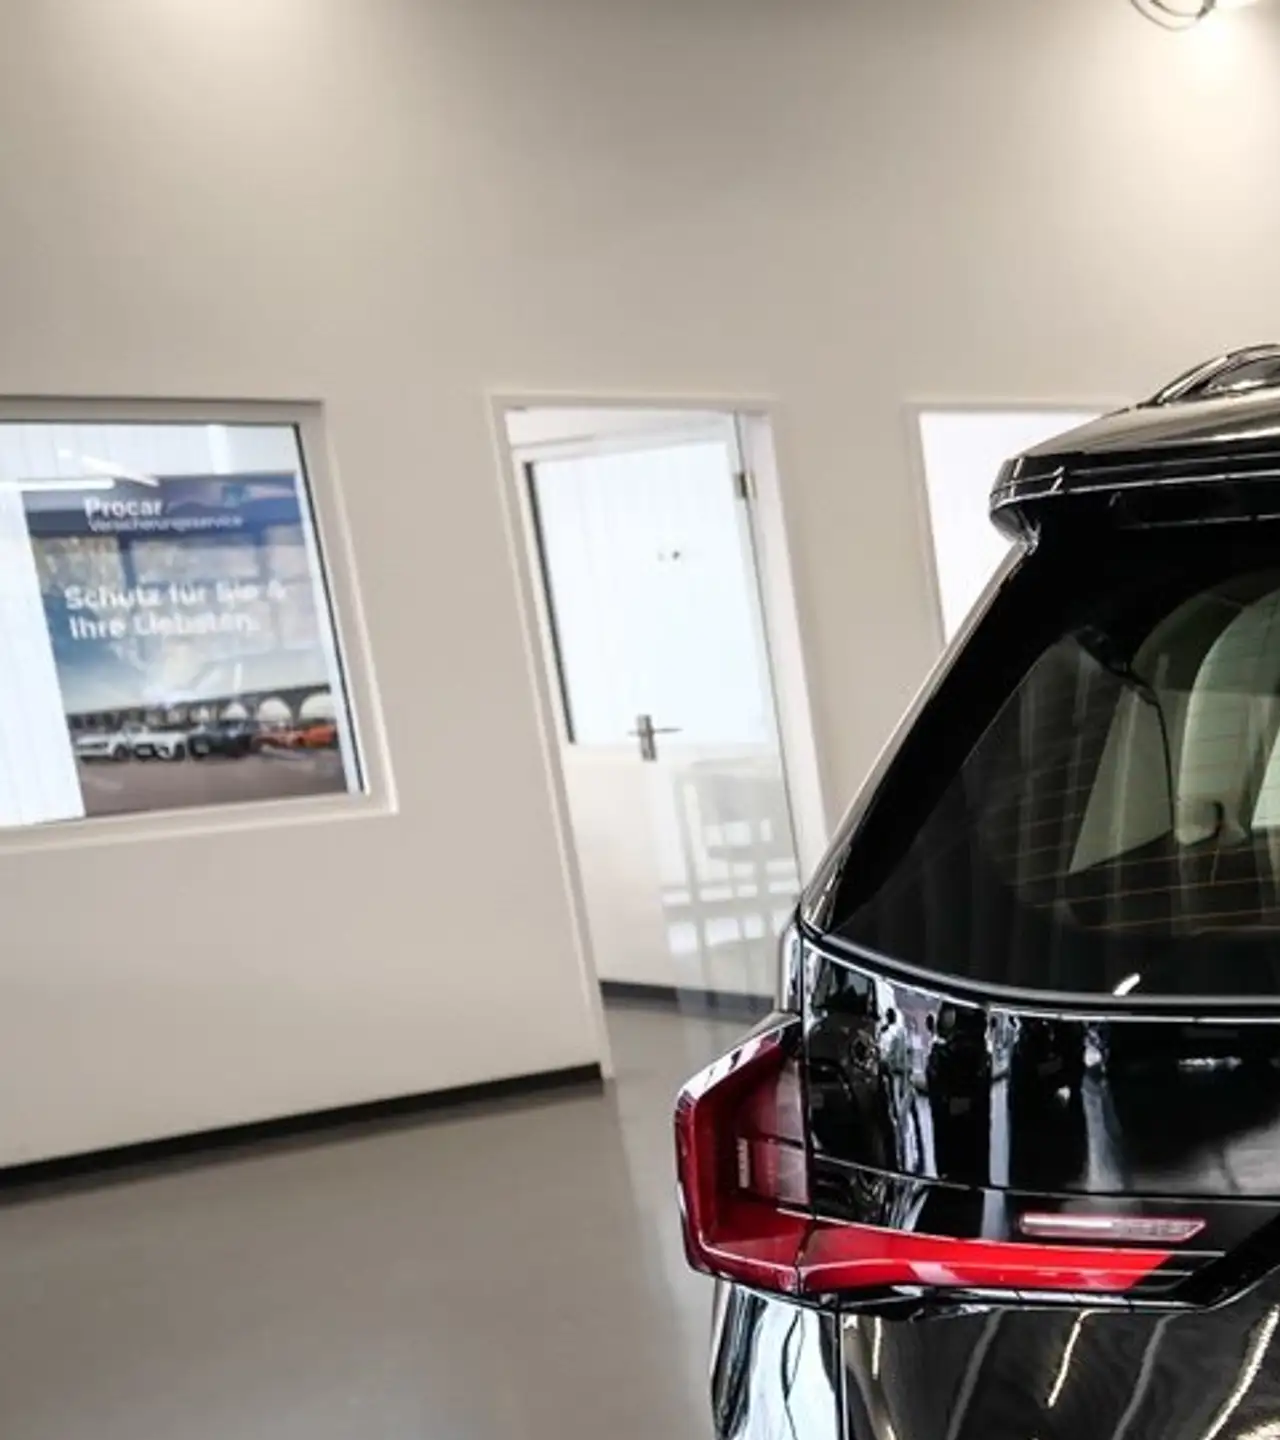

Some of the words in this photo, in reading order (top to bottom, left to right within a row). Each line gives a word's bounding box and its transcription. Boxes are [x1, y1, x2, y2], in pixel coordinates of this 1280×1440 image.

[84, 496, 163, 517] Procar
[64, 583, 162, 611] Schutz
[69, 614, 127, 639] Ihre
